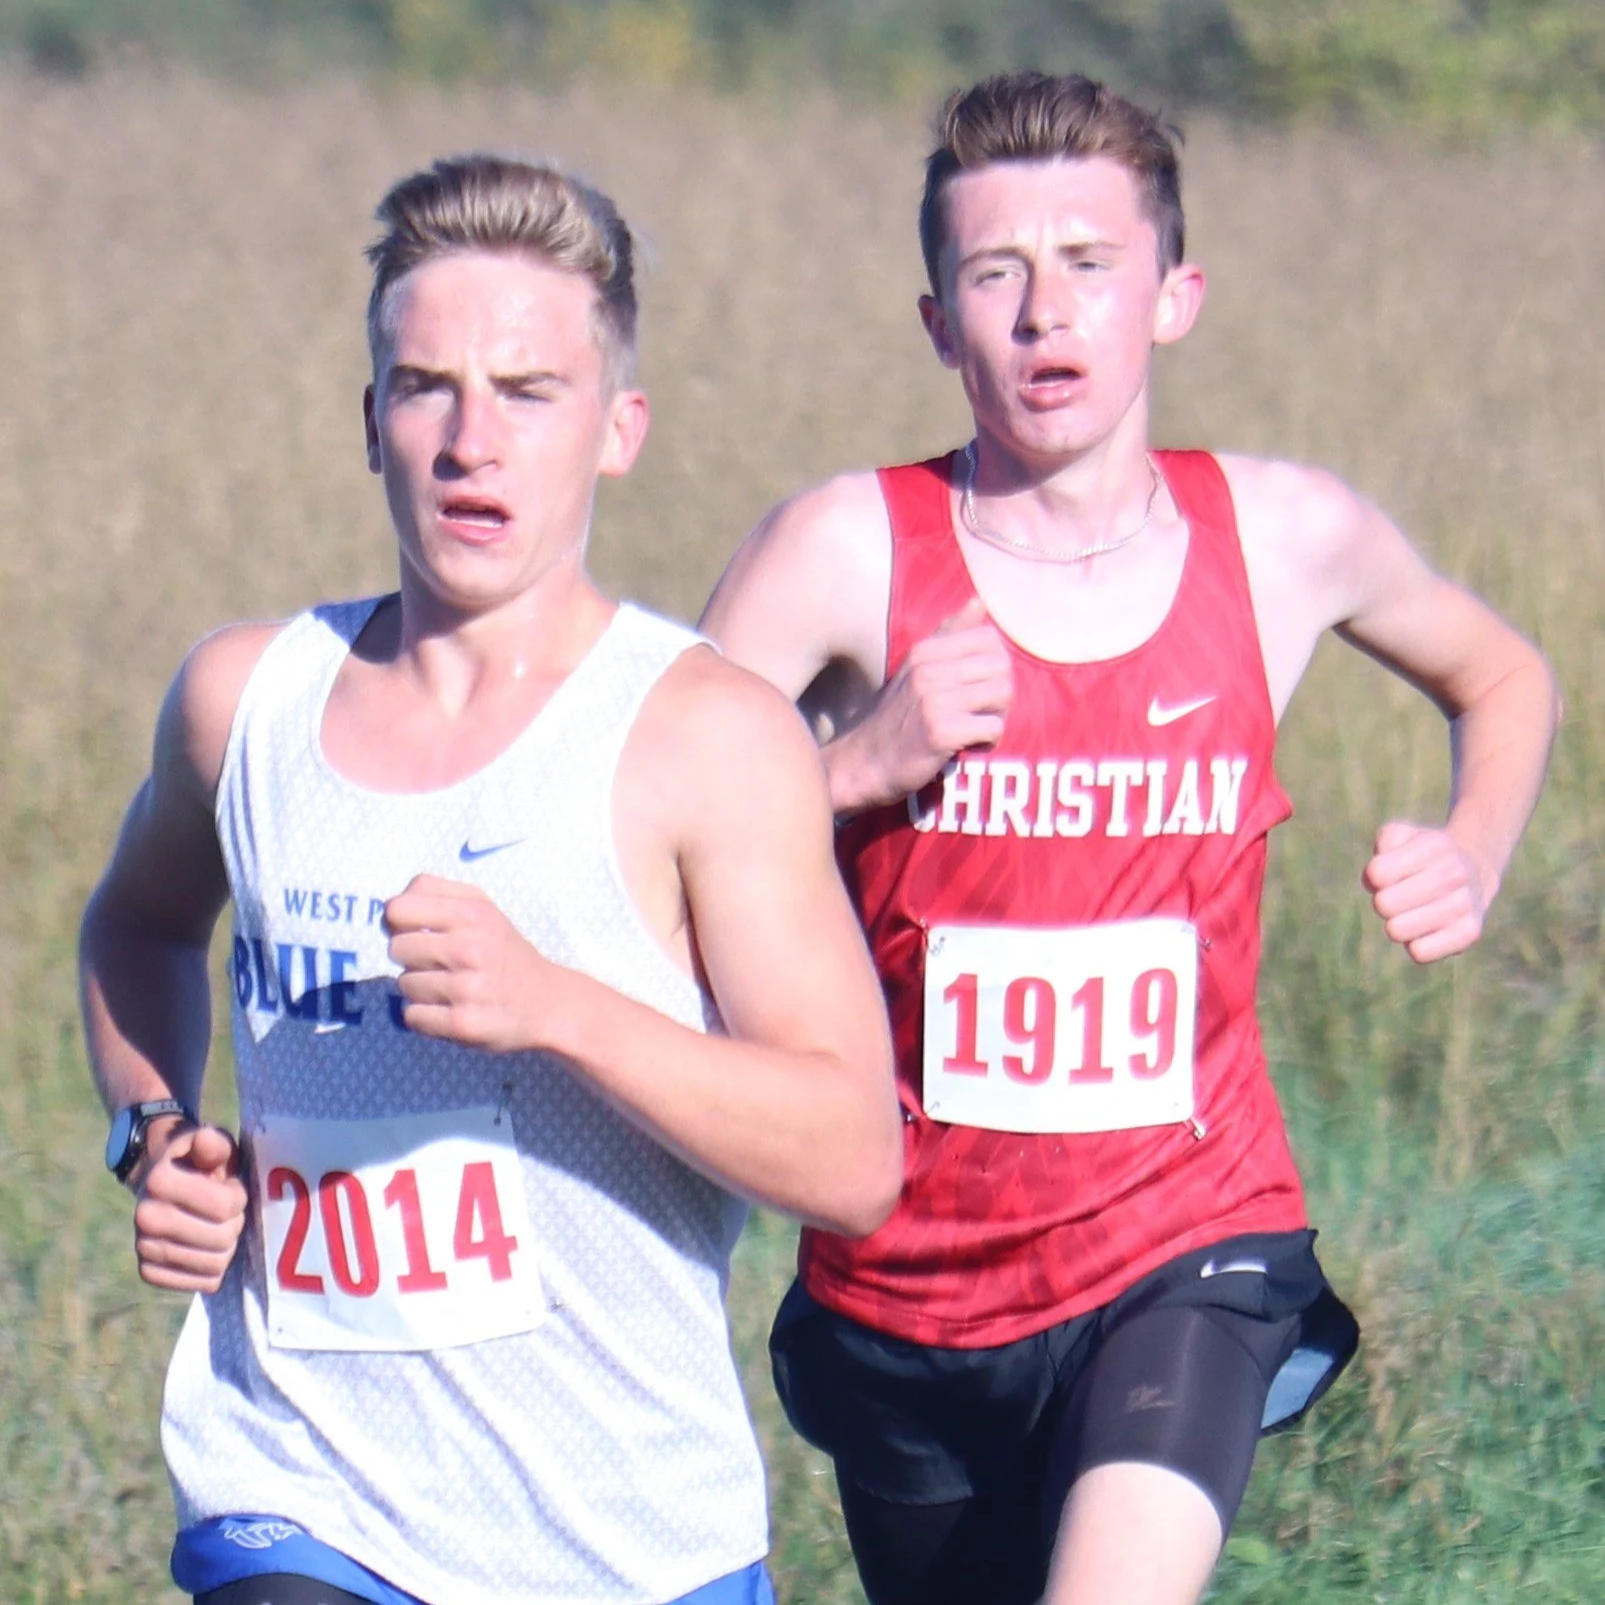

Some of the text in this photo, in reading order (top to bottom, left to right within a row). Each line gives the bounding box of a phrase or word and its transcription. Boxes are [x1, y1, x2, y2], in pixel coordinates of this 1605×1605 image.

[907, 759, 1247, 837] CHRISTIAN
[284, 888, 358, 925] WEST
[234, 935, 363, 1026] BLUE
[943, 967, 1178, 1086] 1919
[267, 1161, 518, 1298] 2014
